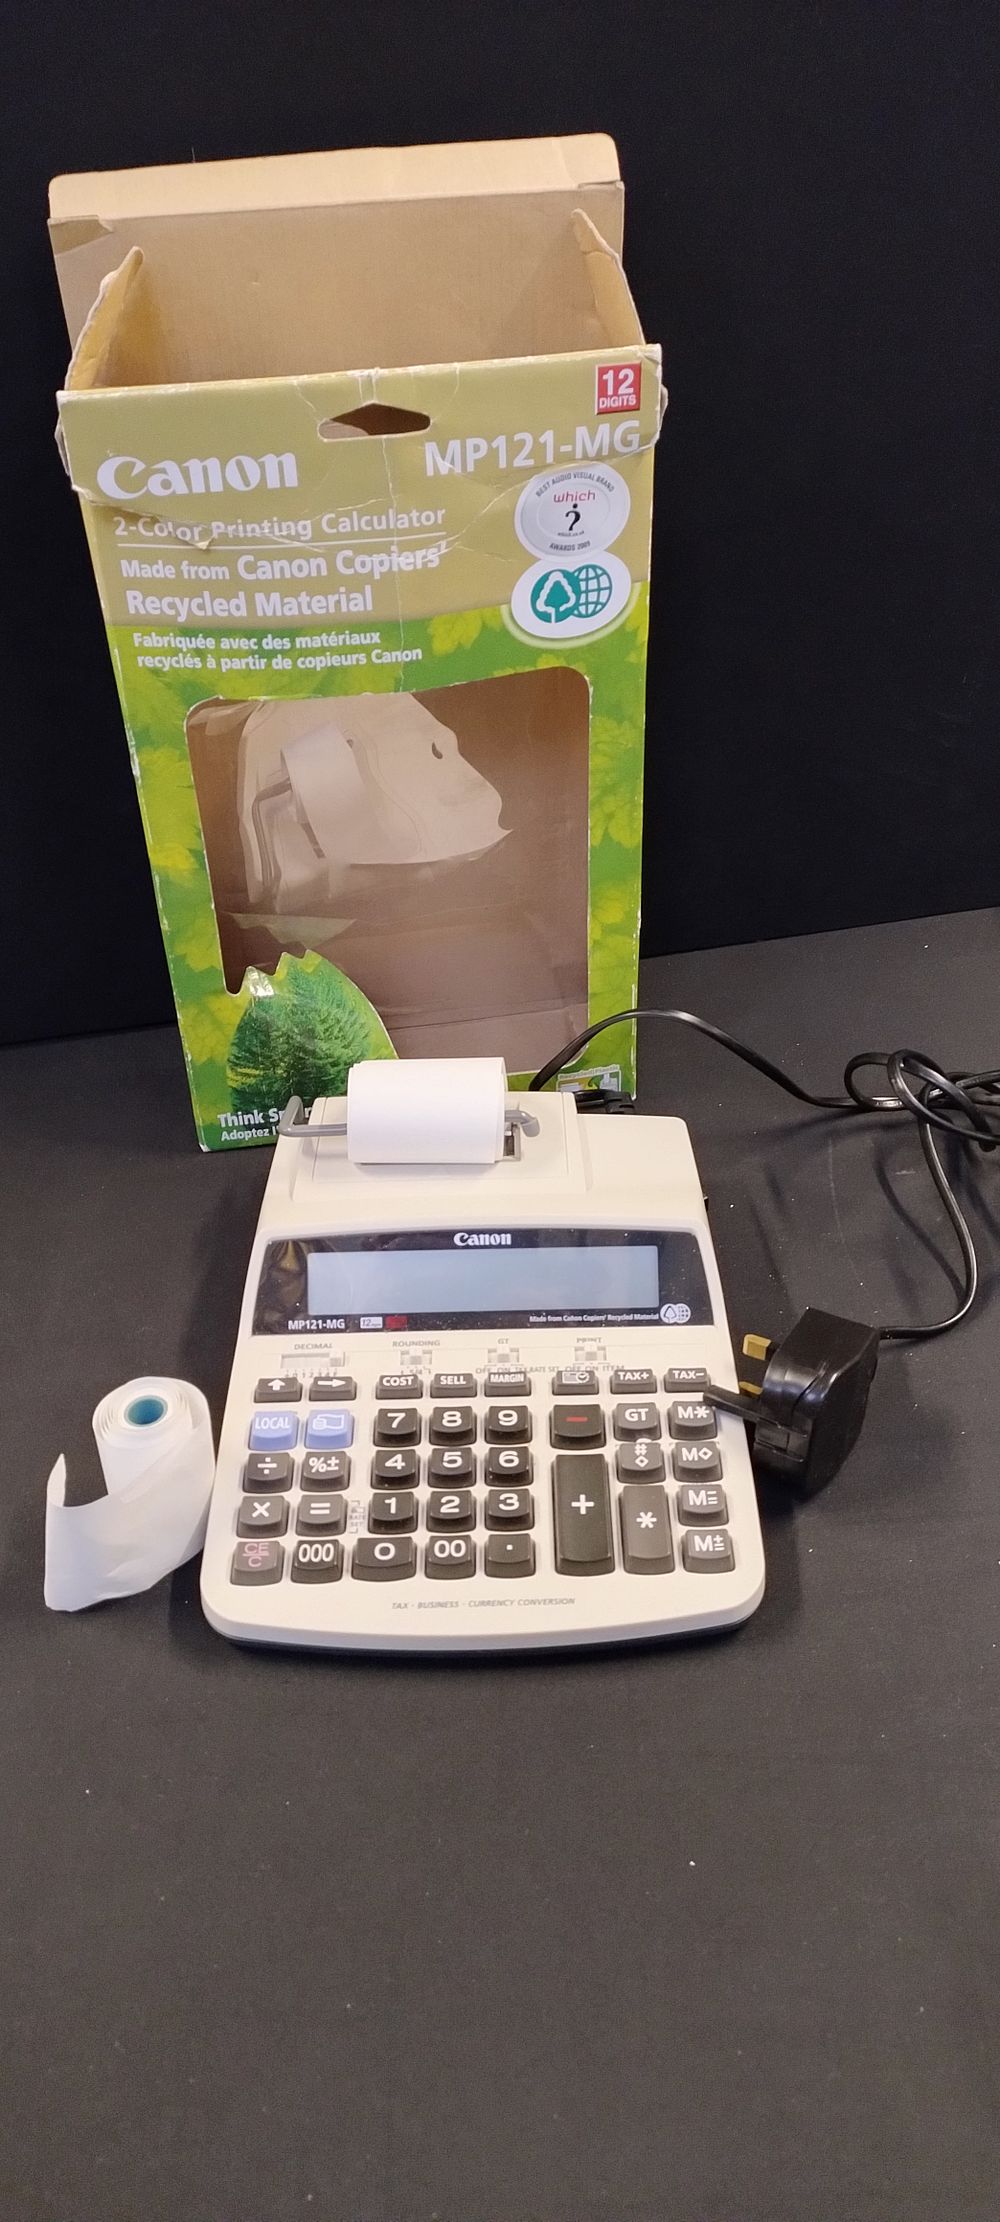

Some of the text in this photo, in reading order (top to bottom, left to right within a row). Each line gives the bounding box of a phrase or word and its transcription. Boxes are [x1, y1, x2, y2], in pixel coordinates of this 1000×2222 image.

[602, 368, 634, 396] 12
[599, 394, 637, 408] DIGITS
[425, 420, 640, 476] MP121-MG
[96, 452, 299, 499] Canon
[536, 472, 615, 497] BEST AUDIO VISUAL BRAND
[553, 490, 596, 503] which
[114, 508, 446, 541] 2-Color Printing Calculator
[549, 542, 576, 551] AWARDS
[120, 559, 176, 579] Made
[181, 560, 230, 580] from
[237, 554, 328, 580] Canon
[126, 585, 373, 622] Recycled Material
[133, 630, 381, 651] Fabriquée avec des matériaux
[137, 648, 423, 672] recyclés à partir de copieurs Canon
[217, 1109, 265, 1128] Think
[221, 1127, 270, 1141] Adoptez
[453, 1232, 512, 1247] Canon
[288, 1319, 346, 1331] MP121-MG
[529, 1315, 547, 1323] Made
[548, 1314, 563, 1322] from
[563, 1314, 582, 1322] Canon
[607, 1313, 633, 1321] Recycled
[634, 1313, 659, 1321] Material
[392, 1340, 441, 1348] ROUNDING
[382, 1375, 415, 1386] COST
[440, 1375, 467, 1385] SELL
[489, 1372, 525, 1384] MARGIN
[617, 1371, 650, 1381] TAX+
[387, 1412, 406, 1428] 7
[442, 1411, 462, 1427] 8
[497, 1410, 518, 1426] 9
[624, 1408, 649, 1421] GT
[255, 1416, 291, 1430] LOCAL
[384, 1453, 405, 1470] 4
[442, 1451, 463, 1468] 5
[498, 1450, 519, 1467] 6
[384, 1497, 397, 1514] 1
[440, 1495, 461, 1513] 2
[498, 1493, 520, 1511] 3
[244, 1542, 269, 1555] CE
[298, 1543, 335, 1562] 000
[373, 1542, 396, 1560] 0
[433, 1539, 466, 1558] 00
[248, 1556, 262, 1567] C
[392, 1597, 576, 1610] TAX BUSINESS CURRENCY CONVERSION
